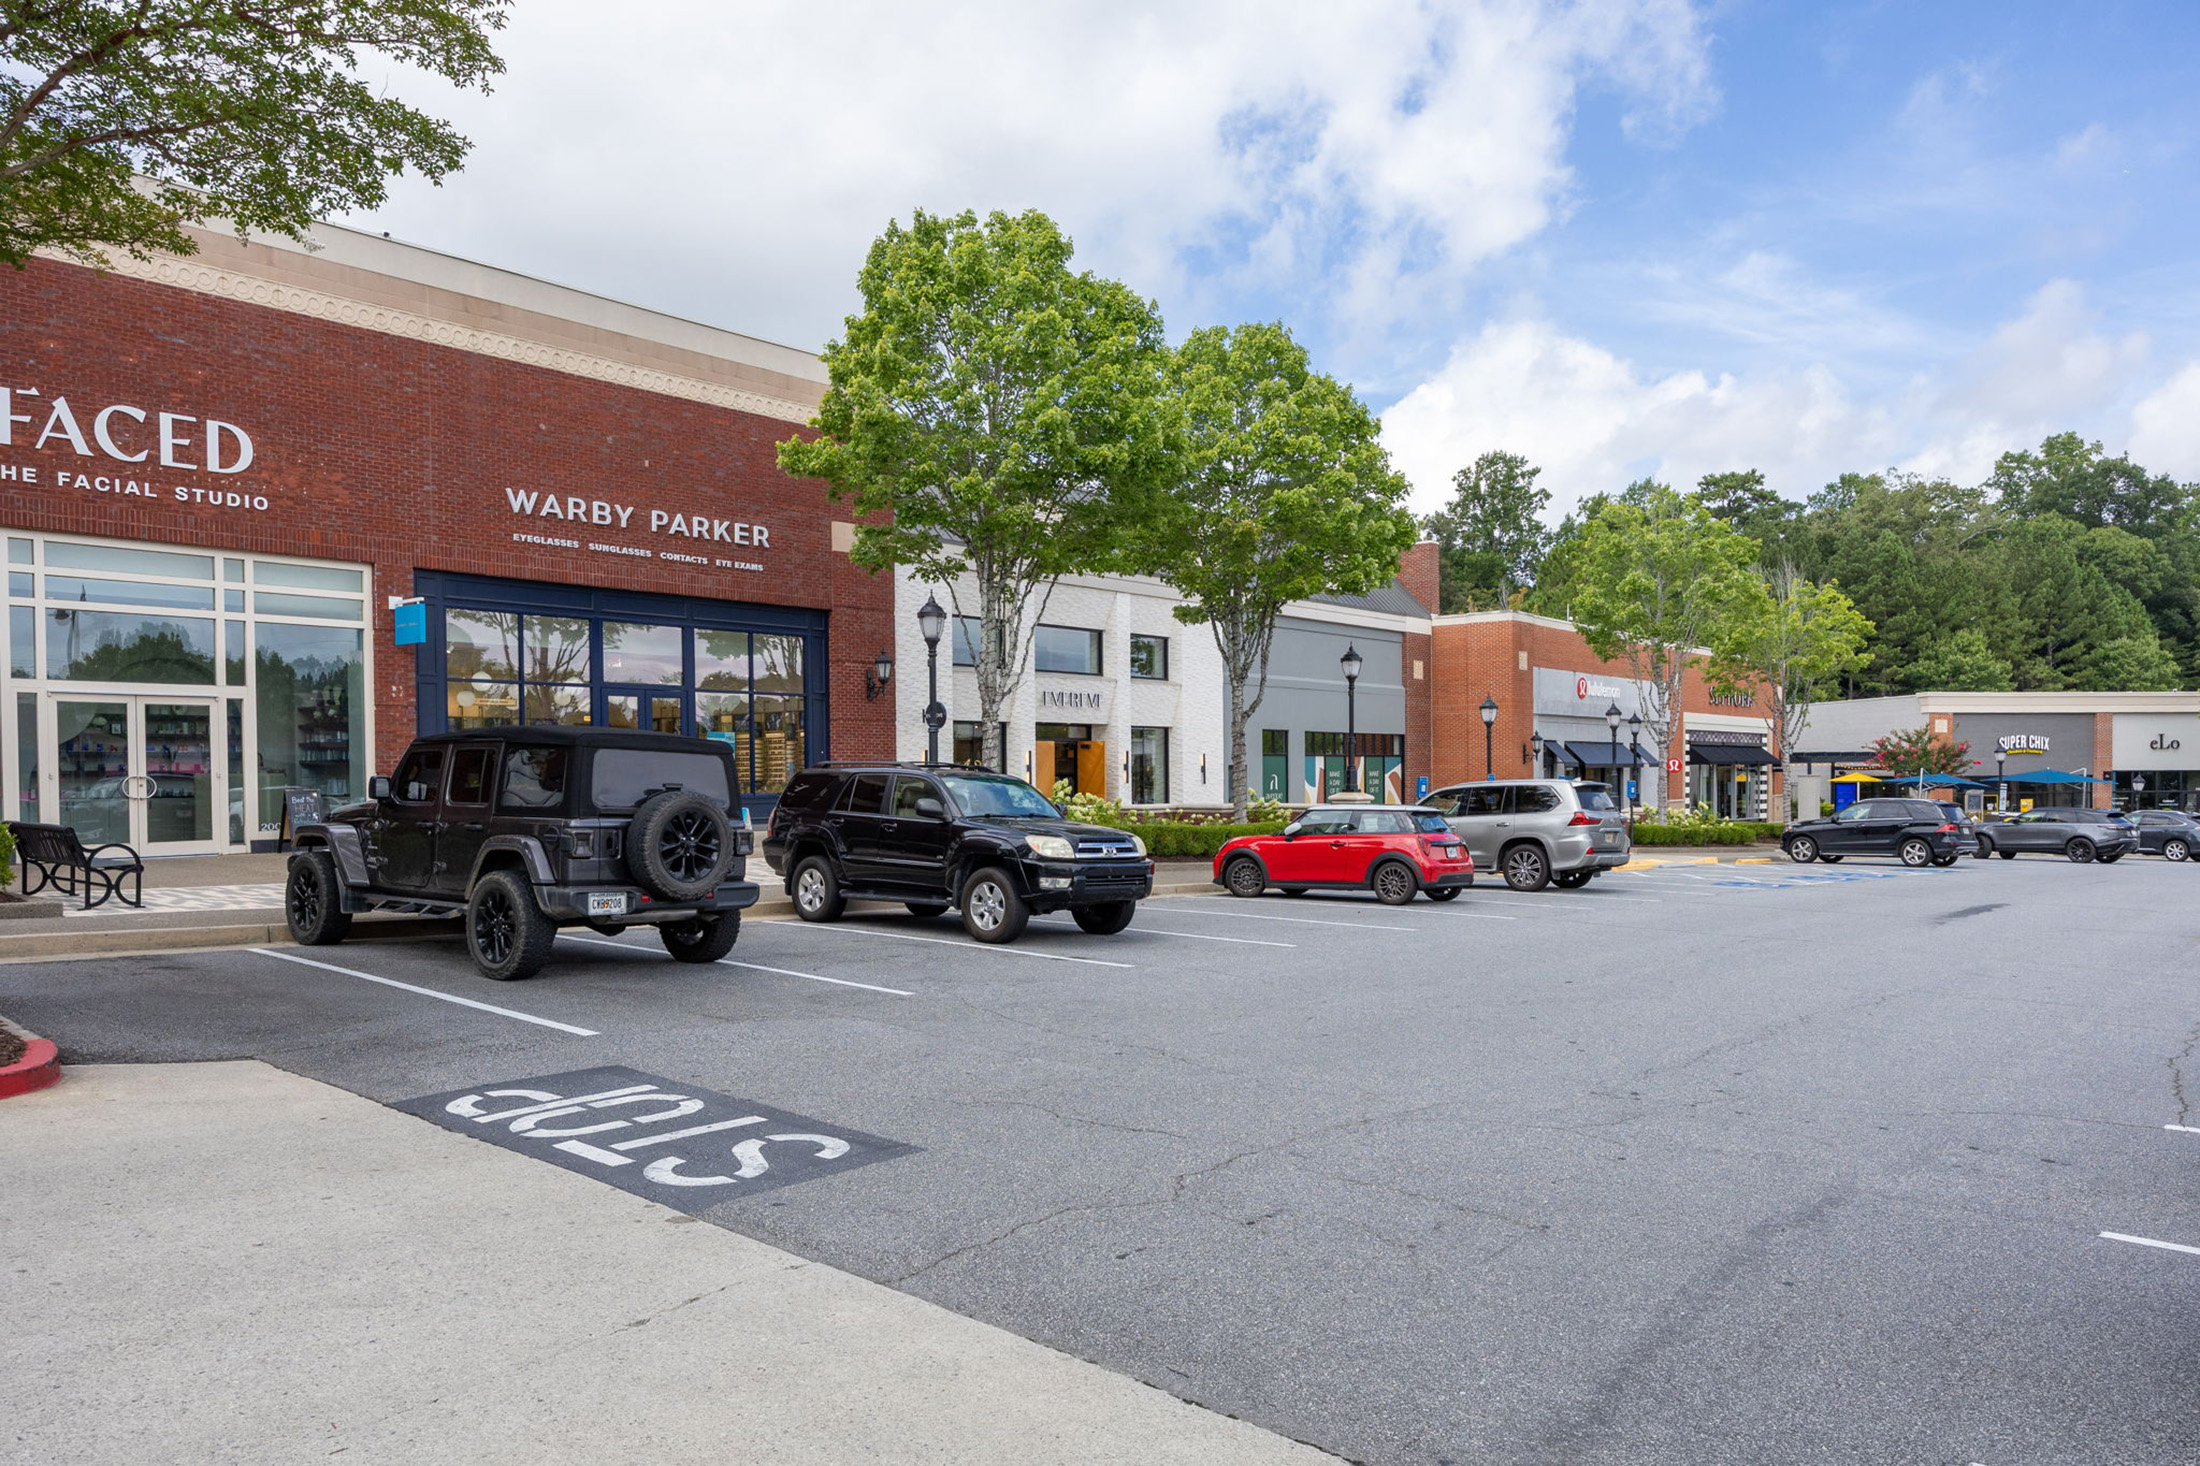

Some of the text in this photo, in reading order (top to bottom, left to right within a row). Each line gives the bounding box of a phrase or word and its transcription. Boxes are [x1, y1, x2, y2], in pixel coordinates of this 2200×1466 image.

[0, 386, 254, 474] FACED
[0, 464, 269, 511] HE FACIAL STUDIO
[505, 487, 770, 548] WARBY PARKER
[513, 533, 764, 572] EYEGLASSES SUNGLASSES CONTACTS EYE EXAMS
[1998, 734, 2050, 751] SUPER CHIX
[2150, 733, 2180, 750] eLo
[445, 1084, 851, 1188] STOP
